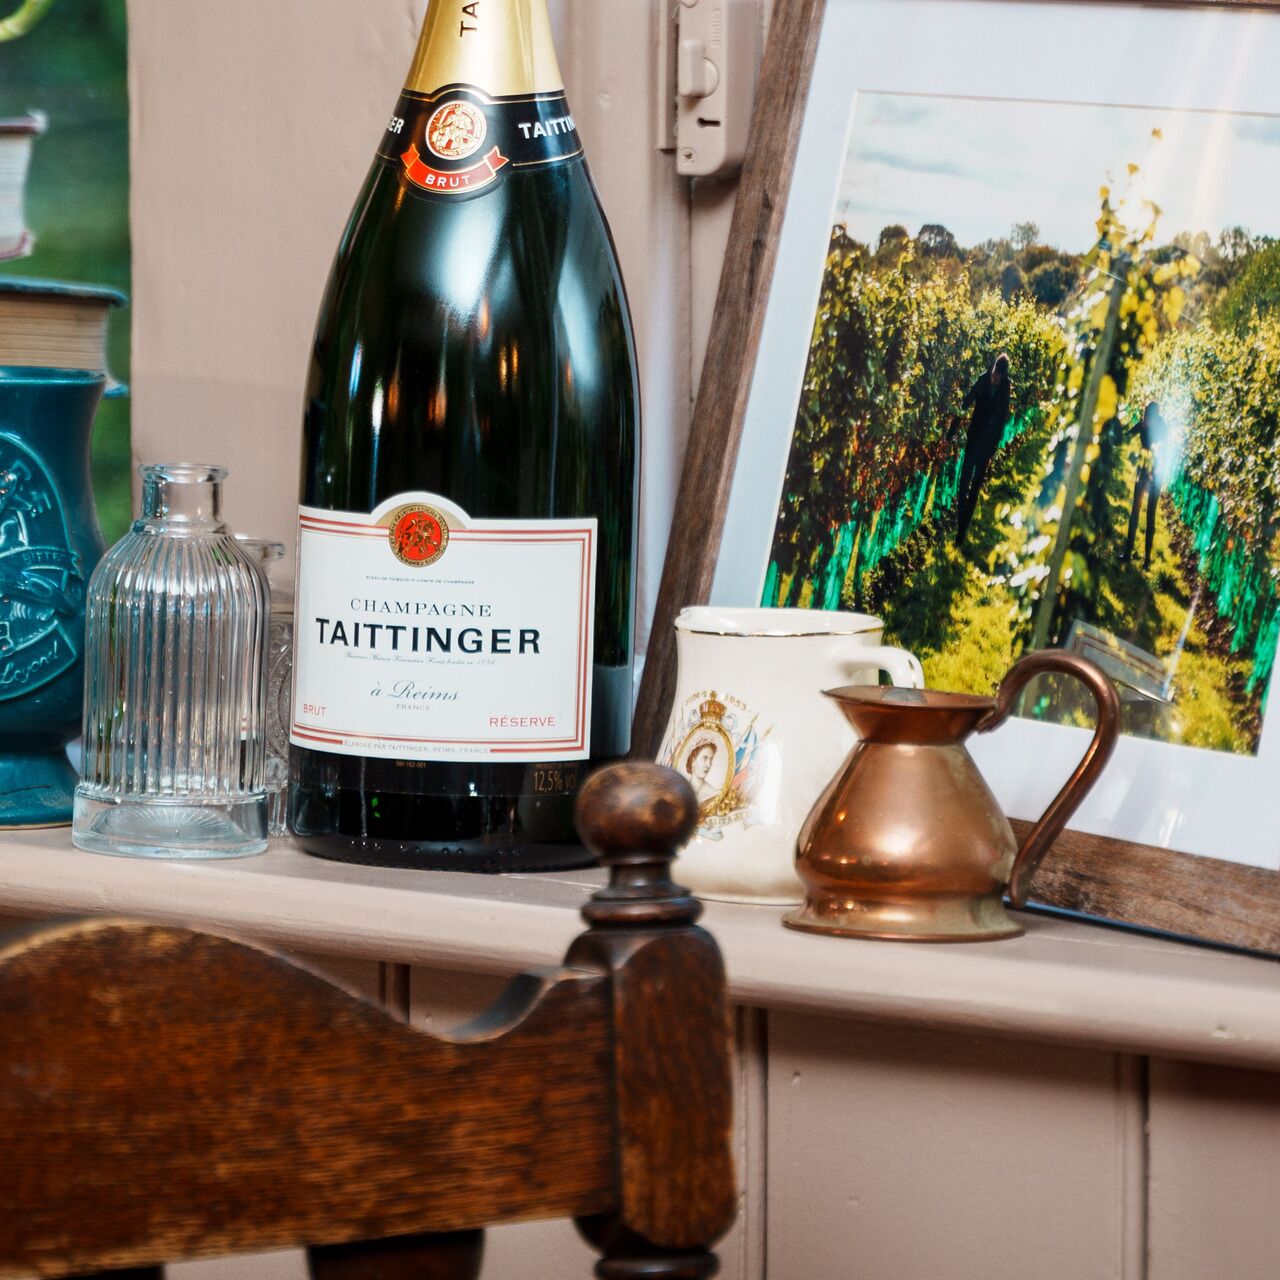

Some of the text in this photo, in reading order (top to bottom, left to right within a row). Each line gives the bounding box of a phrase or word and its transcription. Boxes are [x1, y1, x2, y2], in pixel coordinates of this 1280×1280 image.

[424, 173, 471, 188] BRUT
[350, 598, 493, 618] CHAMPAGNE
[315, 617, 541, 655] TAITTINGER
[370, 677, 461, 702] à Reims
[302, 703, 327, 717] BRUT
[395, 703, 431, 712] FRANCE
[488, 713, 556, 728] RÉSERVE
[533, 770, 563, 793] 12,5%
